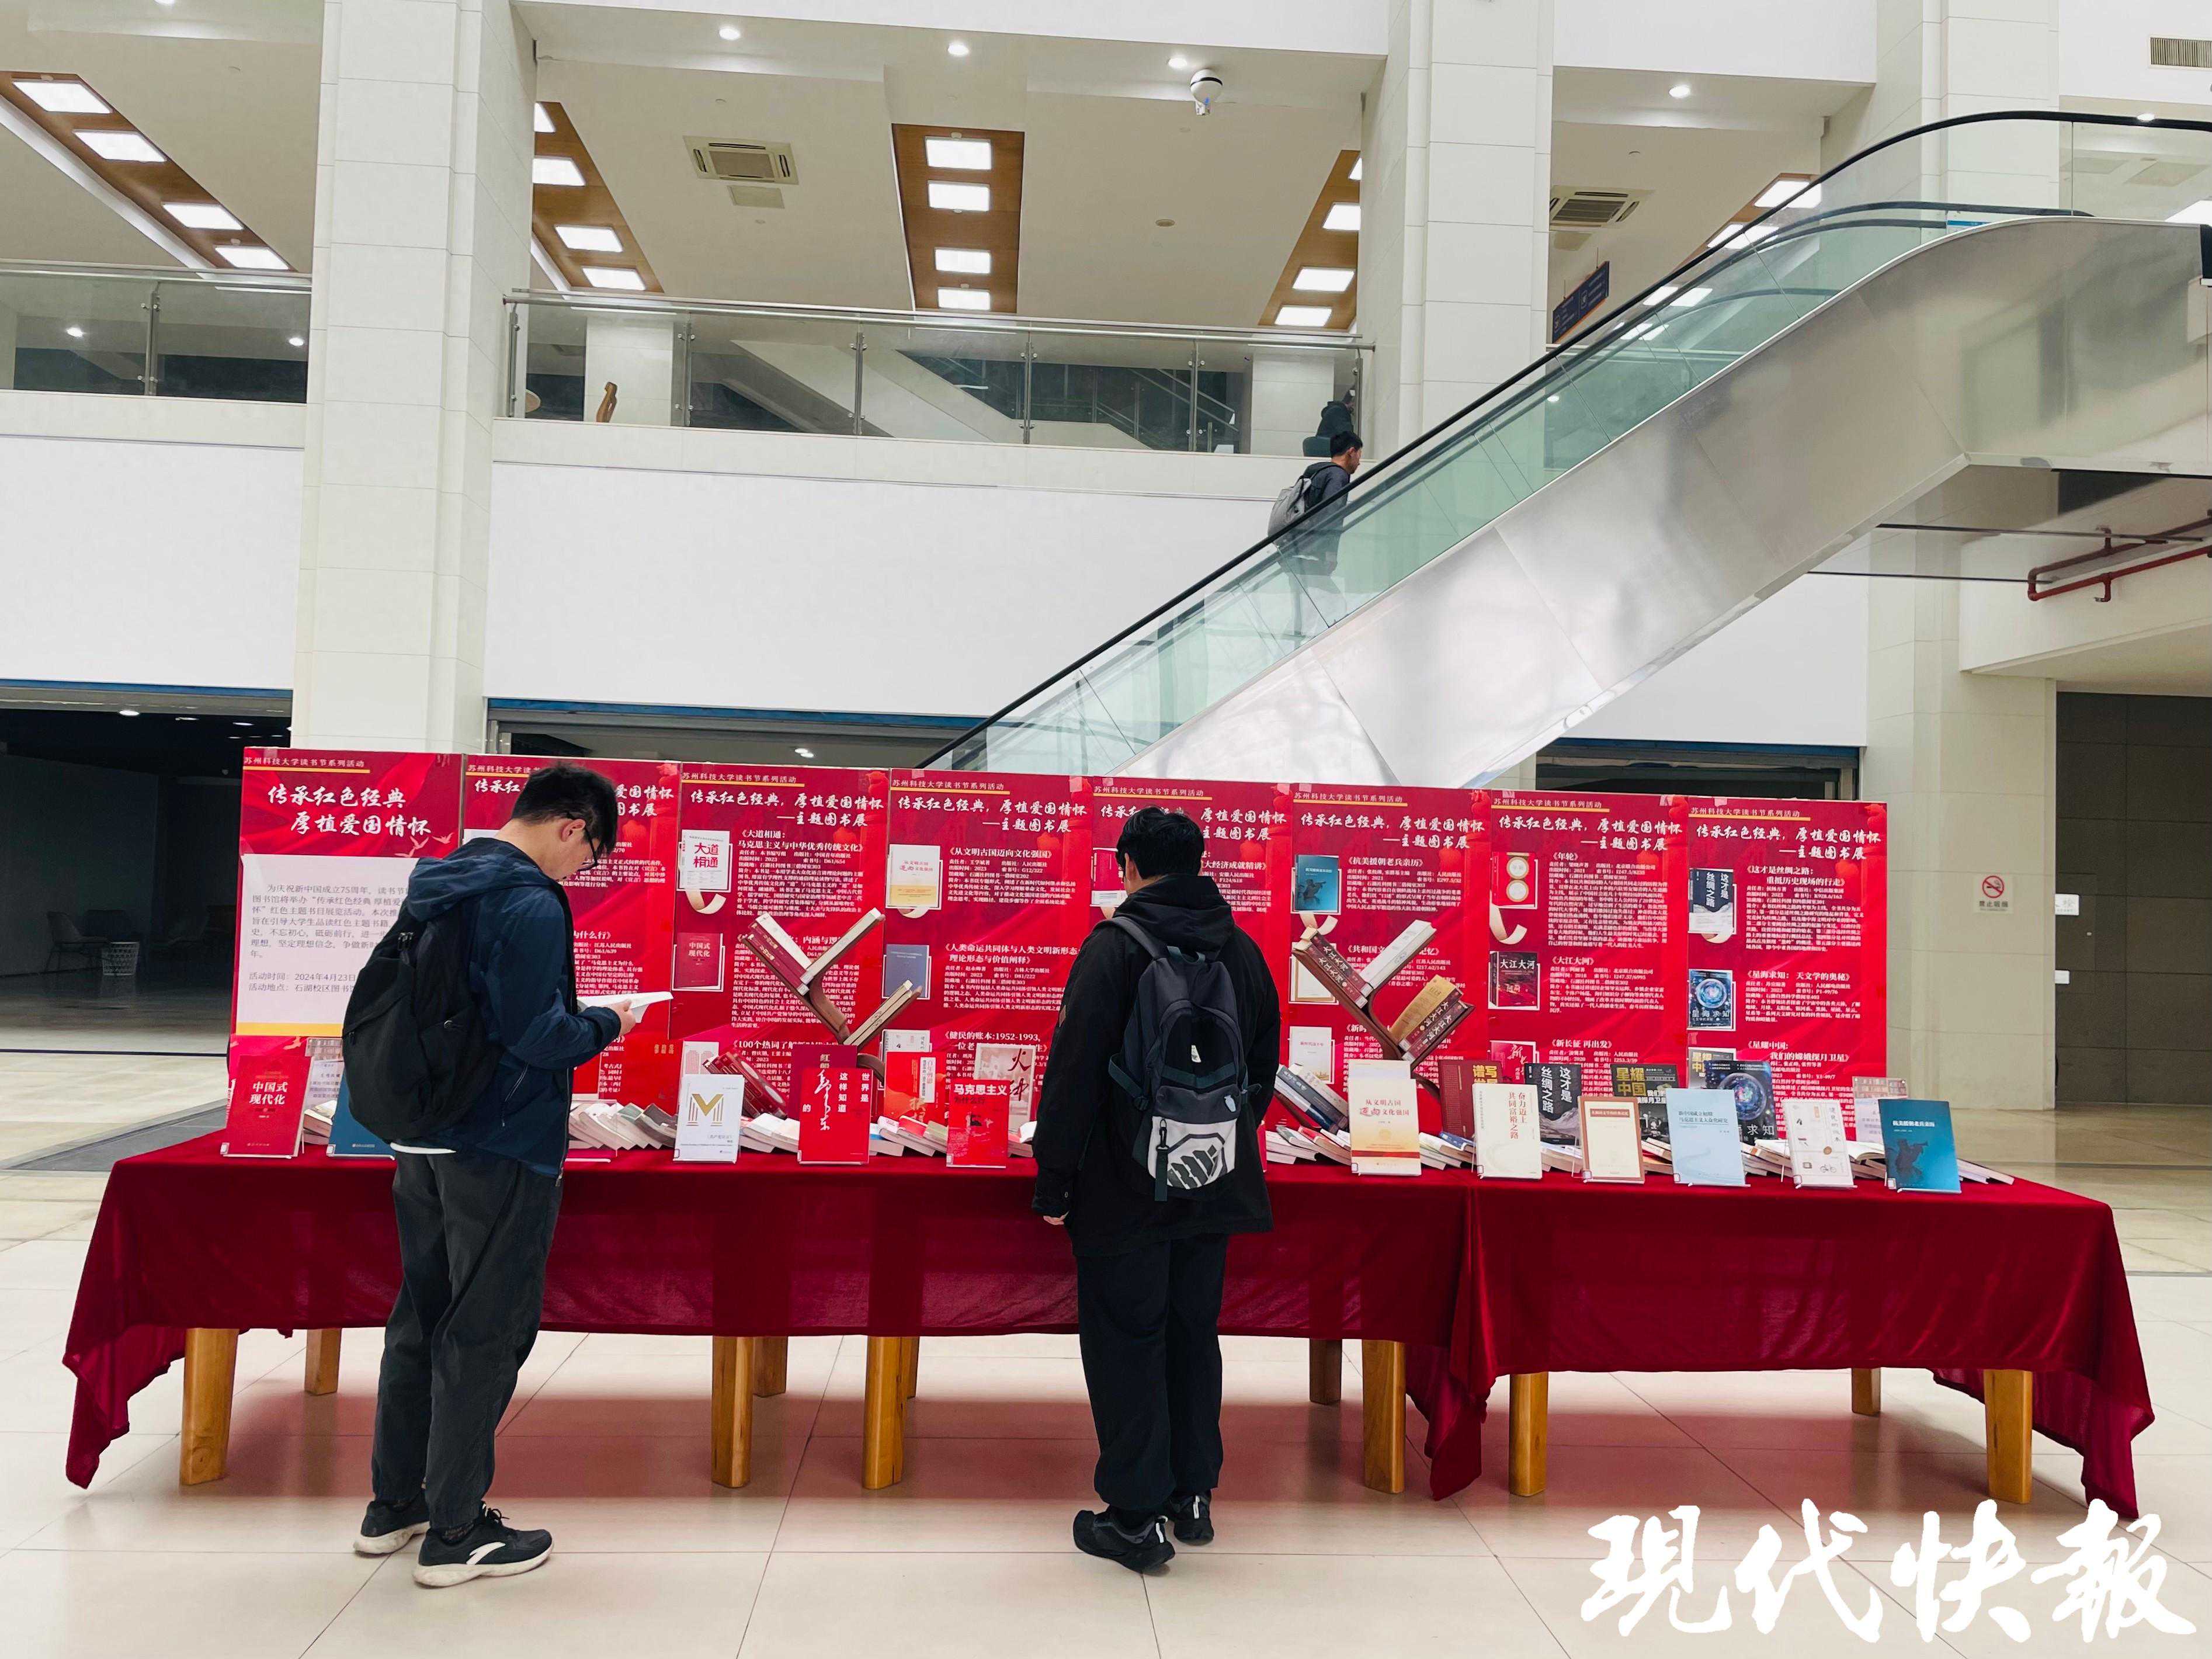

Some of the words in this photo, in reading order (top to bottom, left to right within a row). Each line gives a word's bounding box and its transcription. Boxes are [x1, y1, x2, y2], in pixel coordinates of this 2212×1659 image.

[244, 757, 364, 768] 苏州科技大学读书节系列活动
[682, 772, 797, 784] 苏州科技大学读书节系列活动
[474, 779, 520, 793] 传承红
[615, 783, 674, 799] 爱国情怀
[892, 779, 1005, 791] 苏州科技大学读书节系列活动
[268, 783, 406, 808] 传承红色经典
[1094, 786, 1204, 797] 苏州科技大学读书节系列活动
[1294, 792, 1403, 803] 苏州科技大学读书节系列活动
[1494, 798, 1602, 808] 苏州科技大学读书节系列活动
[1200, 807, 1287, 824] 厚植爱国情怀
[1691, 807, 1800, 817] 苏州科技大学读书节系列活动
[290, 811, 431, 837] 厚植爱国情怀
[1202, 825, 1272, 841] 主题图书展
[694, 842, 718, 855] 大道
[950, 847, 1052, 859] 《从文明古国迈向文化强国》
[693, 856, 718, 868] 相通
[1349, 856, 1423, 867] 《抗美援朝老兵亲历》
[1766, 876, 1846, 886] 重抵历史现场的行走》
[688, 949, 710, 957] 现代化
[949, 954, 1031, 964] 理论形态与价值阐释》
[1323, 945, 1349, 971] 大江大河
[1500, 959, 1535, 969] 大江大河
[1553, 956, 1595, 965] 《大江大河》
[1319, 957, 1344, 983] 大江大河
[1796, 971, 1850, 981] 天文学的奥秘》
[1424, 1001, 1449, 1027] 大江大河
[1426, 1014, 1453, 1040] 大江大河
[1551, 1039, 1581, 1047] 《新长征
[1583, 1040, 1613, 1049] 再出发》
[1770, 1051, 1850, 1062] 我们的嫦娥探月卫星》
[1473, 1065, 1497, 1077] 谱写
[1616, 1067, 1645, 1081] 星耀
[252, 1081, 289, 1094] 中国式
[860, 1073, 870, 1103] 世界是
[954, 1084, 1008, 1096] 马克思主义
[1540, 1067, 1554, 1114] 丝绸之路
[1559, 1066, 1573, 1103] 这才是
[1617, 1082, 1647, 1096] 中国
[838, 1072, 849, 1113] 这样知道
[249, 1094, 286, 1105] 现代化
[803, 1104, 811, 1112] 的
[1359, 1107, 1410, 1117] 迈向文化强国
[1509, 1092, 1519, 1140] 共同富裕之路
